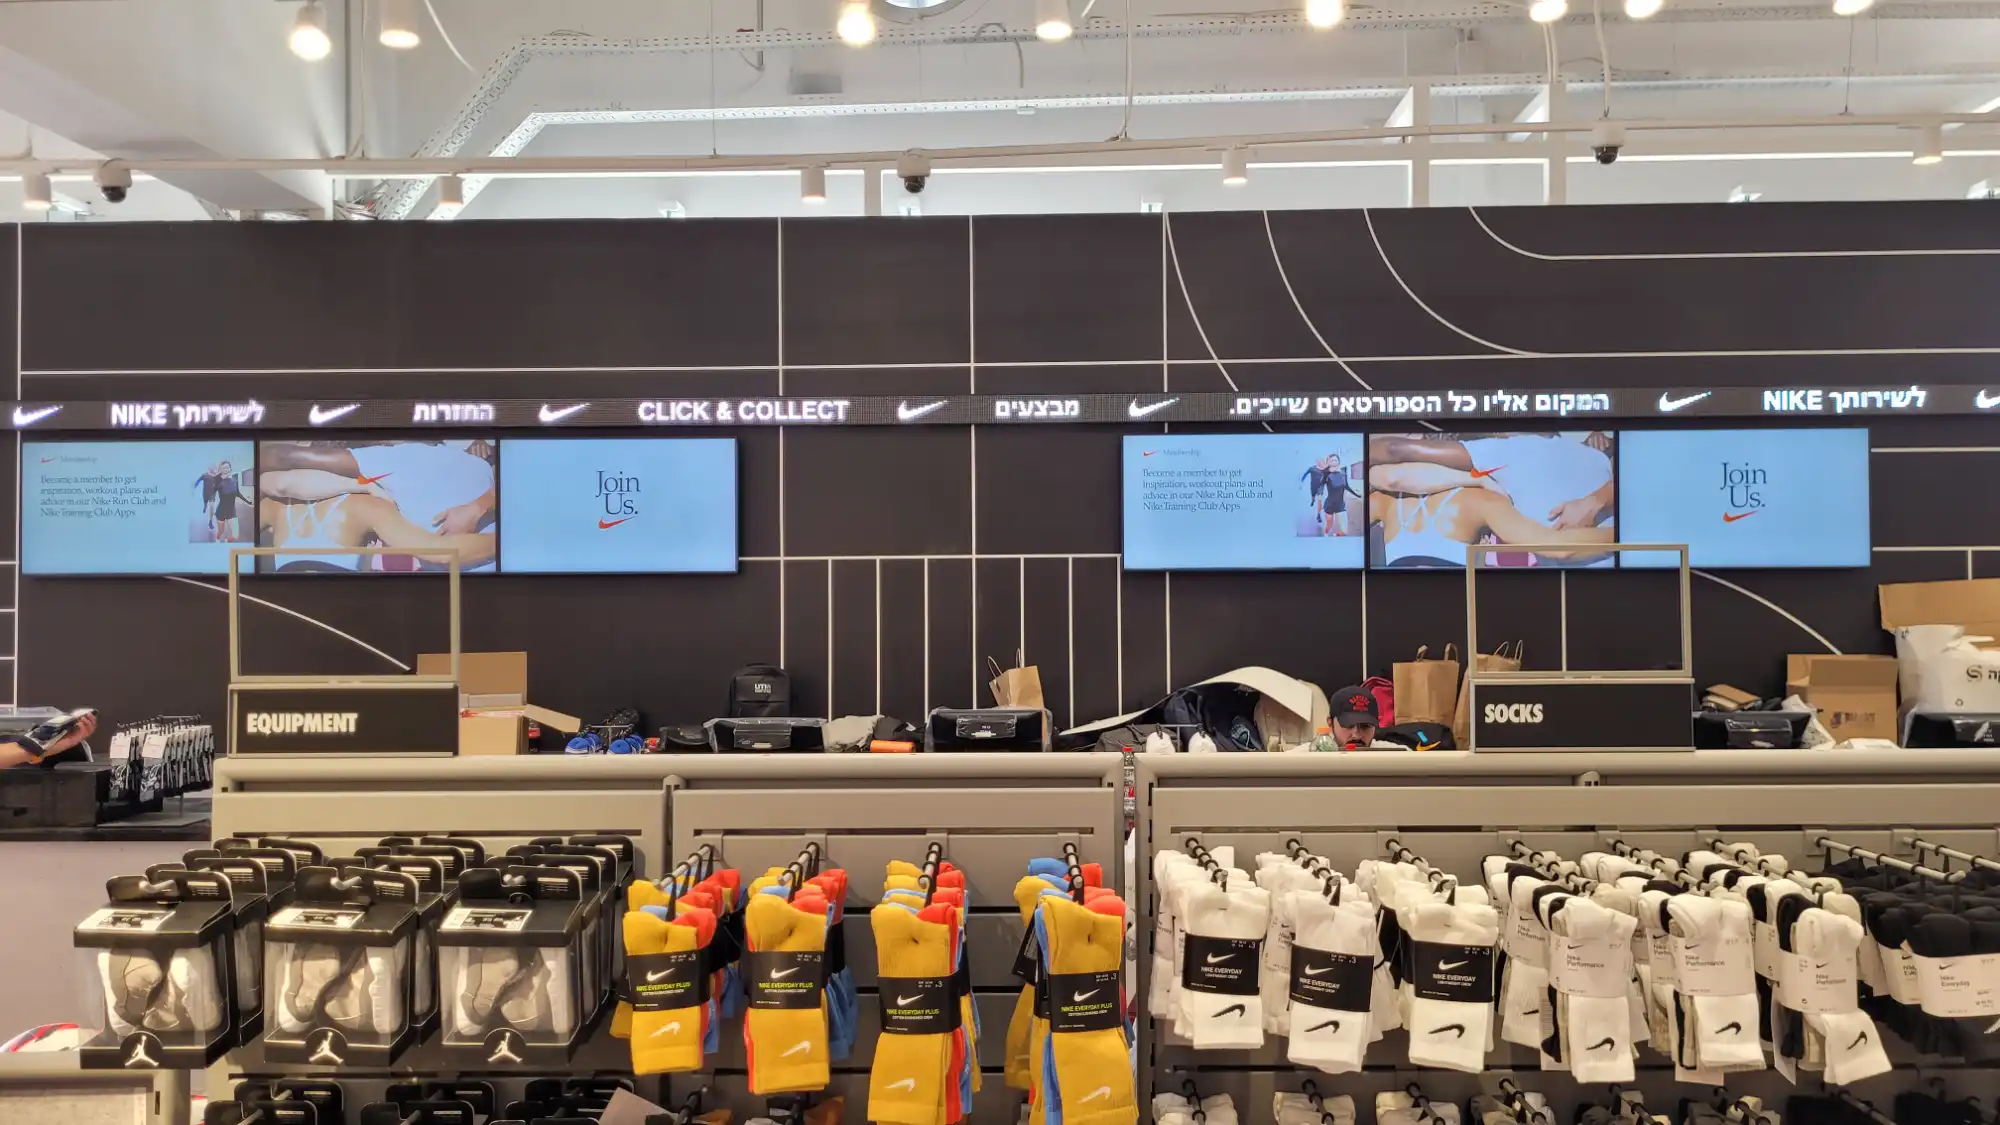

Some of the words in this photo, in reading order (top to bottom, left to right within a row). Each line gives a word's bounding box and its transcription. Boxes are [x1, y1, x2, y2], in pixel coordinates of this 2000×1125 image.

[994, 398, 1081, 419] מבצעים
[1229, 397, 1309, 415] שייכים.
[1316, 395, 1442, 415] הספורטאים
[1447, 390, 1477, 413] כל
[1483, 389, 1529, 412] אליו
[1535, 393, 1610, 416] המקום
[1763, 390, 1823, 411] NIKE
[1827, 386, 1928, 413] לשירותך
[111, 402, 168, 426] NIKE
[172, 398, 266, 429] לשירותך
[413, 402, 495, 422] החזרות
[638, 401, 711, 422] CLICK
[716, 402, 732, 421] &
[738, 400, 851, 421] COLLECT
[80, 475, 113, 484] member
[115, 475, 123, 484] to
[124, 476, 137, 486] get
[595, 470, 641, 498] Join
[1143, 468, 1175, 478] Become
[1183, 468, 1217, 477] member
[1219, 469, 1228, 477] to
[1229, 469, 1242, 480] get
[1143, 479, 1187, 490] inspiration,
[1188, 479, 1223, 488] workout
[1224, 479, 1246, 490] plans
[1247, 478, 1264, 488] and
[1720, 462, 1767, 490] Join
[84, 486, 118, 495] workout
[120, 486, 141, 496] plans
[142, 486, 158, 494] and
[91, 496, 111, 505] Nike
[112, 496, 129, 505] Run
[130, 496, 150, 505] Club
[151, 496, 167, 505] and
[1143, 490, 1168, 499] advice
[1169, 490, 1178, 499] in
[1195, 490, 1215, 499] Nike
[1216, 490, 1234, 499] Run
[1235, 490, 1256, 499] Club
[1257, 489, 1273, 498] and
[1727, 485, 1766, 508] Us.
[40, 508, 60, 517] Nike
[93, 507, 113, 516] Club
[114, 508, 136, 518] Apps
[602, 492, 639, 515] Us.
[1143, 502, 1163, 511] Nike
[1163, 502, 1197, 512] Training
[1197, 501, 1218, 510] Club
[1218, 501, 1241, 512] Apps
[1484, 703, 1544, 724] SOCKS
[246, 712, 359, 736] EQUIPMENT
[1214, 967, 1242, 975] EVERYDAY
[1446, 974, 1476, 982] EVERYDAY
[648, 983, 676, 991] EVERYDAY
[675, 981, 691, 989] PLUS
[1299, 977, 1312, 985] NIKE
[1311, 979, 1340, 989] EVERYDAY
[1075, 1004, 1100, 1012] EVERYDAY
